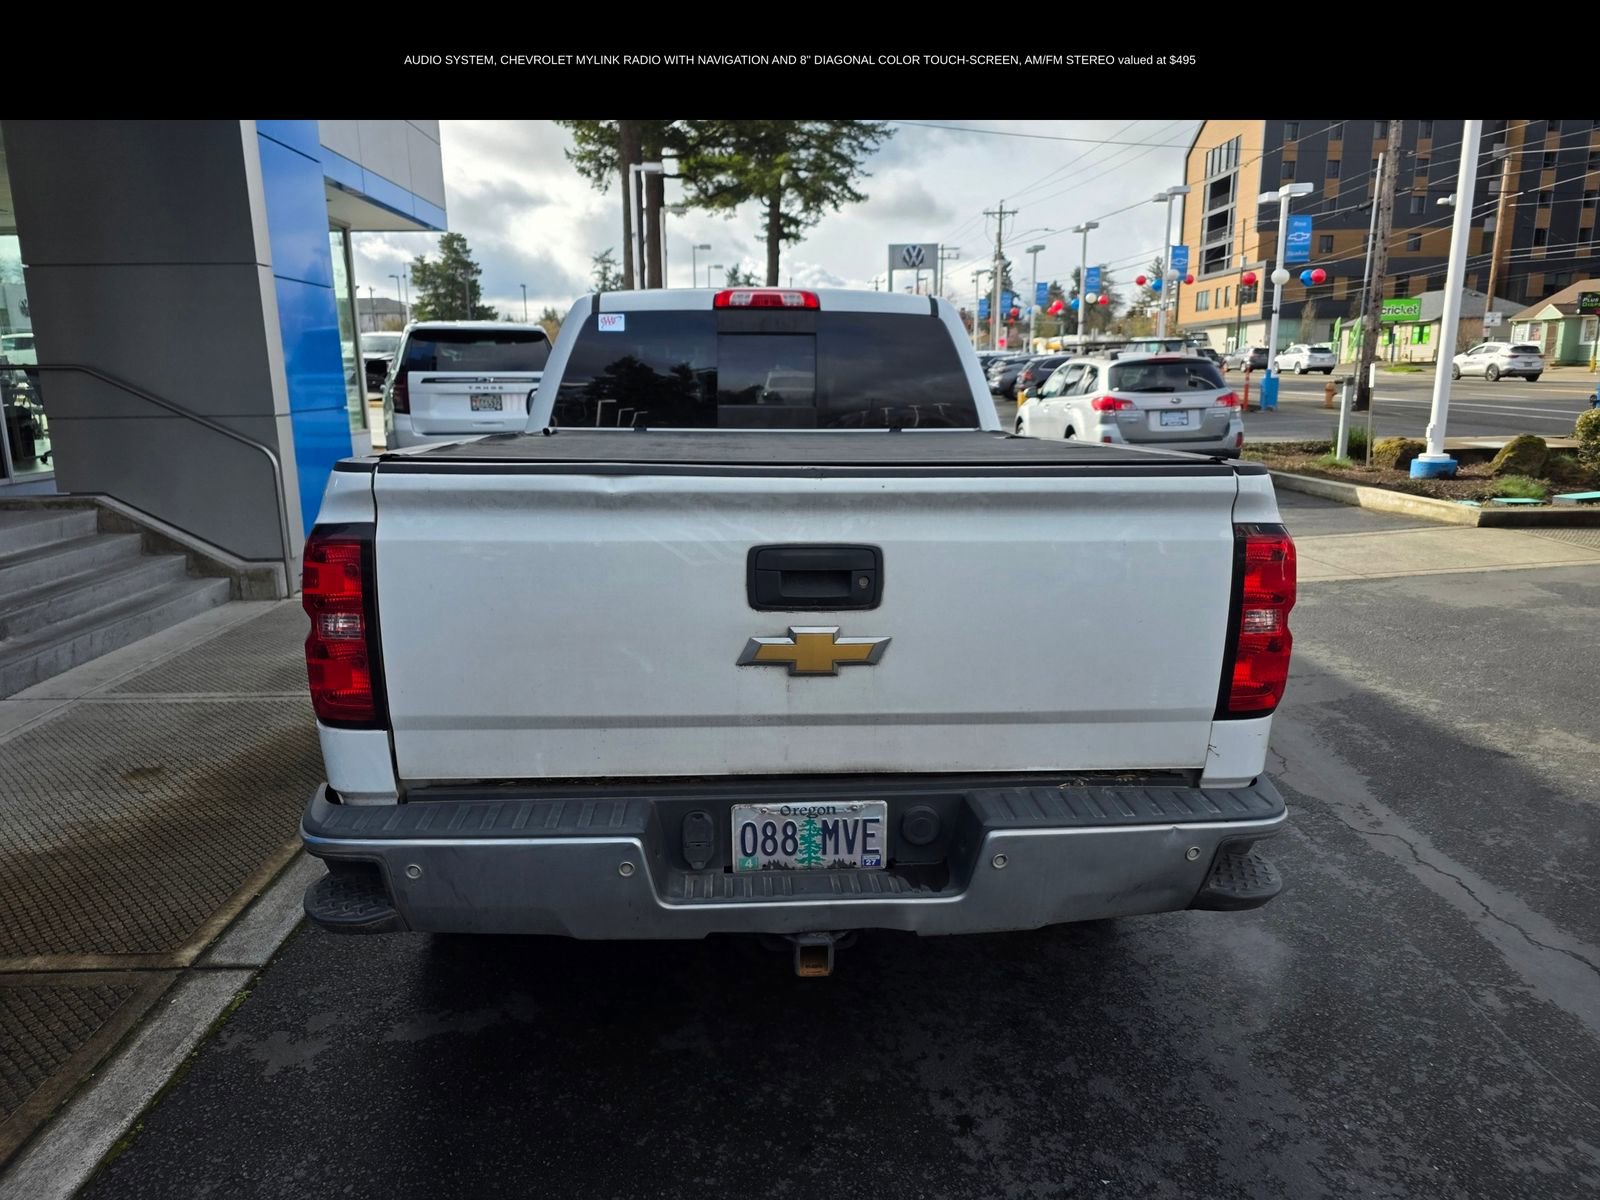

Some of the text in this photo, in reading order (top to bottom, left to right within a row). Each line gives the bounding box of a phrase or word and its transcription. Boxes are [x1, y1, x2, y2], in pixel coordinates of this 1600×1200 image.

[1381, 305, 1417, 315] cricket
[780, 804, 837, 818] Oregon
[740, 818, 880, 857] 088 MVE
[744, 859, 753, 868] 4
